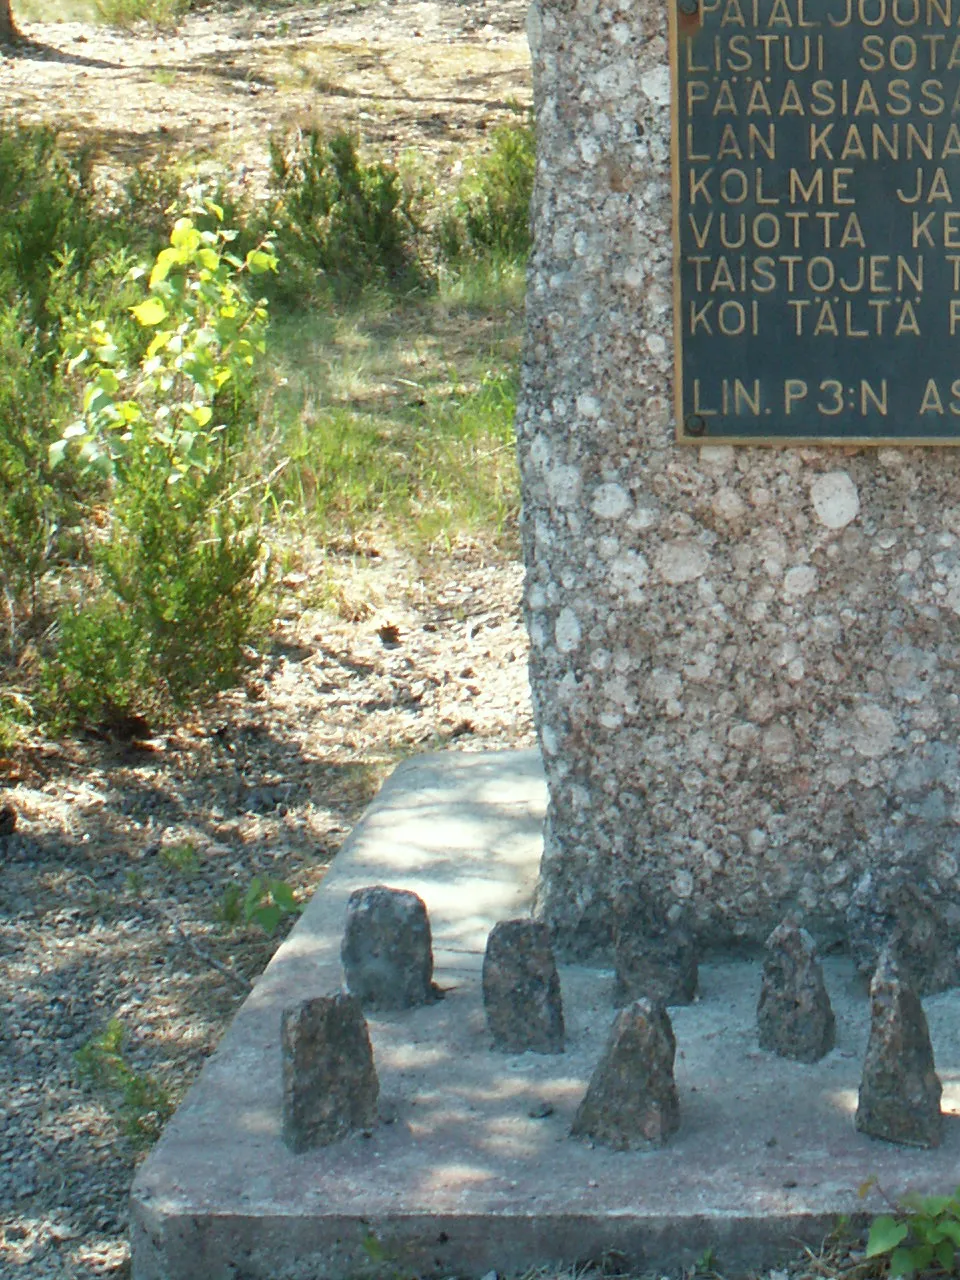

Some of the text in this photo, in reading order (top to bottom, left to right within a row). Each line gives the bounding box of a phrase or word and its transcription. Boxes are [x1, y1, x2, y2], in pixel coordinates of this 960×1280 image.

[686, 34, 824, 72] LISTUI
[686, 123, 776, 160] LAN
[689, 168, 856, 205] KOLME
[896, 168, 952, 204] JA
[688, 212, 866, 249] VUOTTA
[689, 255, 923, 293] TAISTOJEN
[689, 300, 758, 337] KOI
[789, 296, 921, 337] TÄLTÄ
